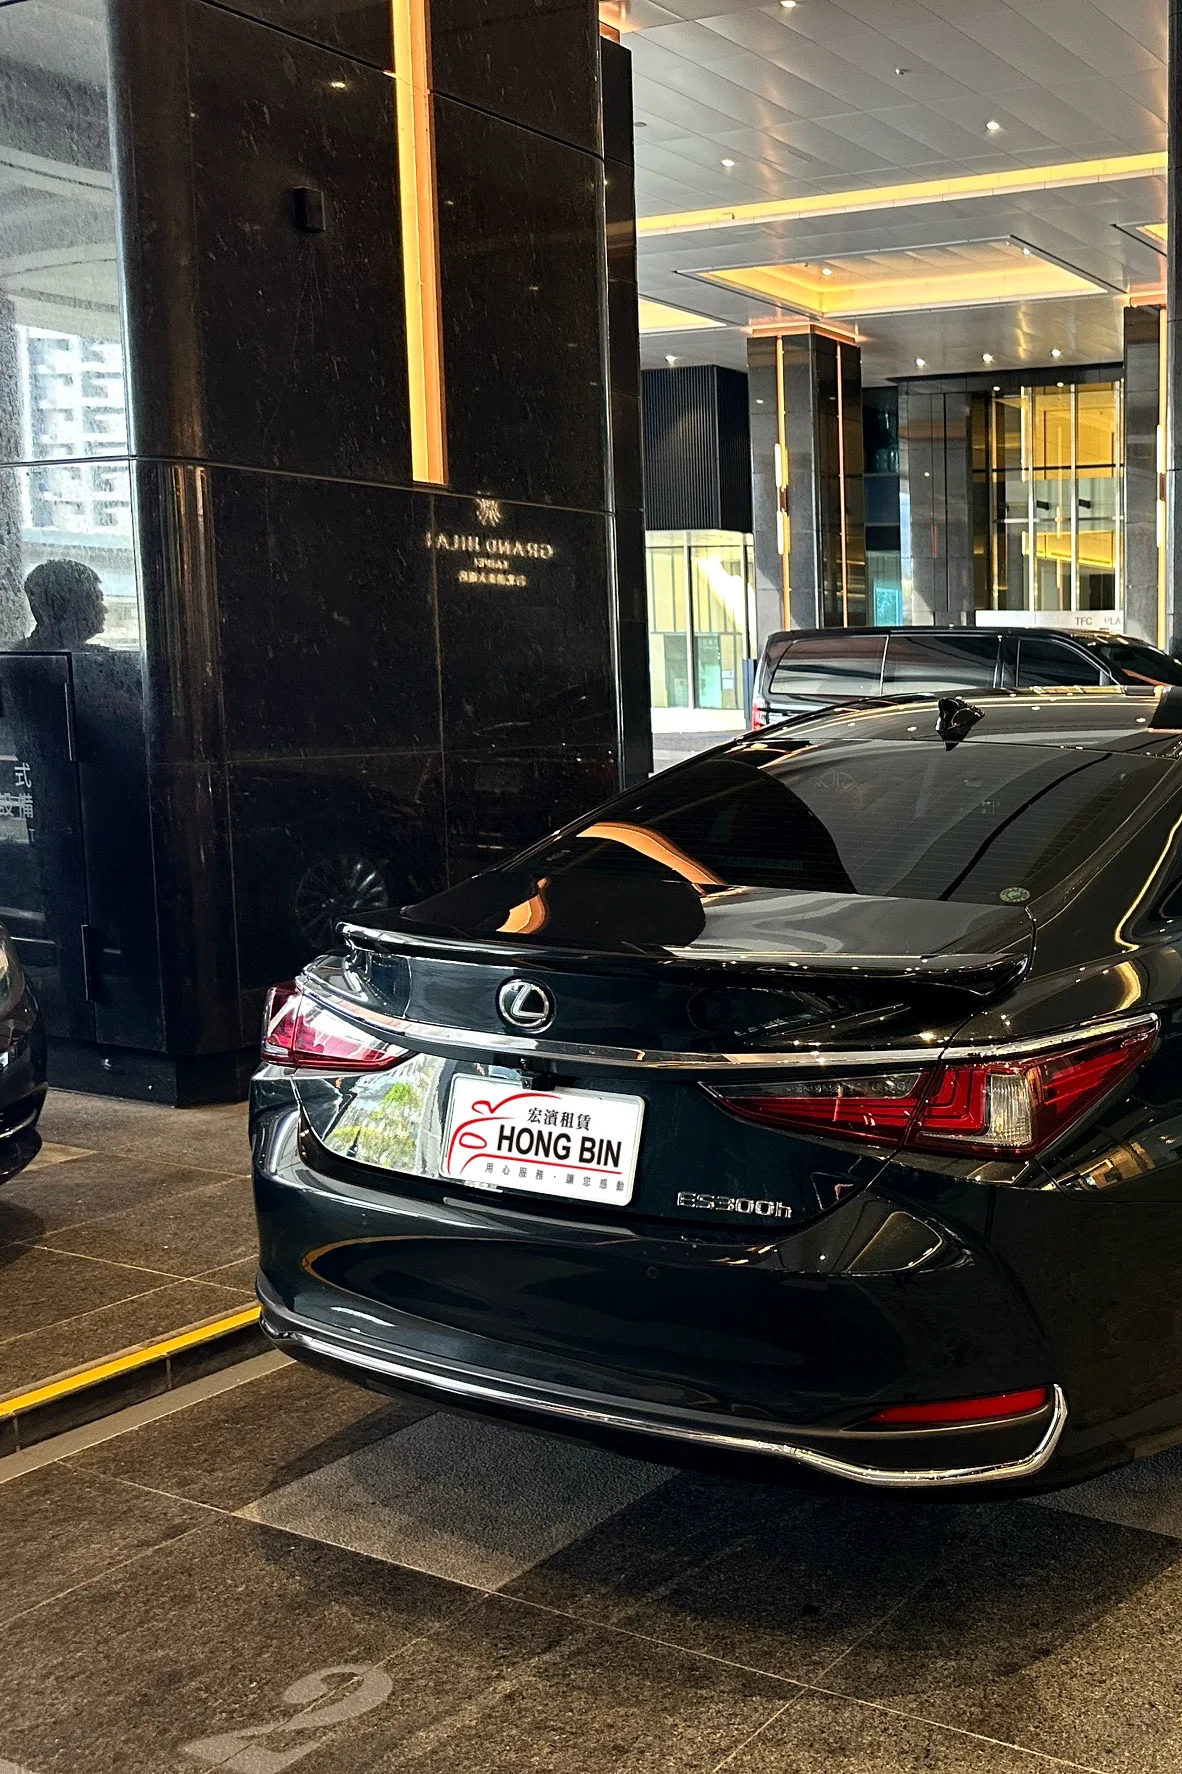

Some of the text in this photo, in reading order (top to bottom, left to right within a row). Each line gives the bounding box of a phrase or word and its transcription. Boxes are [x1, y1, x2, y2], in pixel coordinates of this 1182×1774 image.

[1075, 616, 1093, 626] TFC
[527, 1107, 592, 1131] 宏濱租賃
[497, 1124, 622, 1168] HONG BIN
